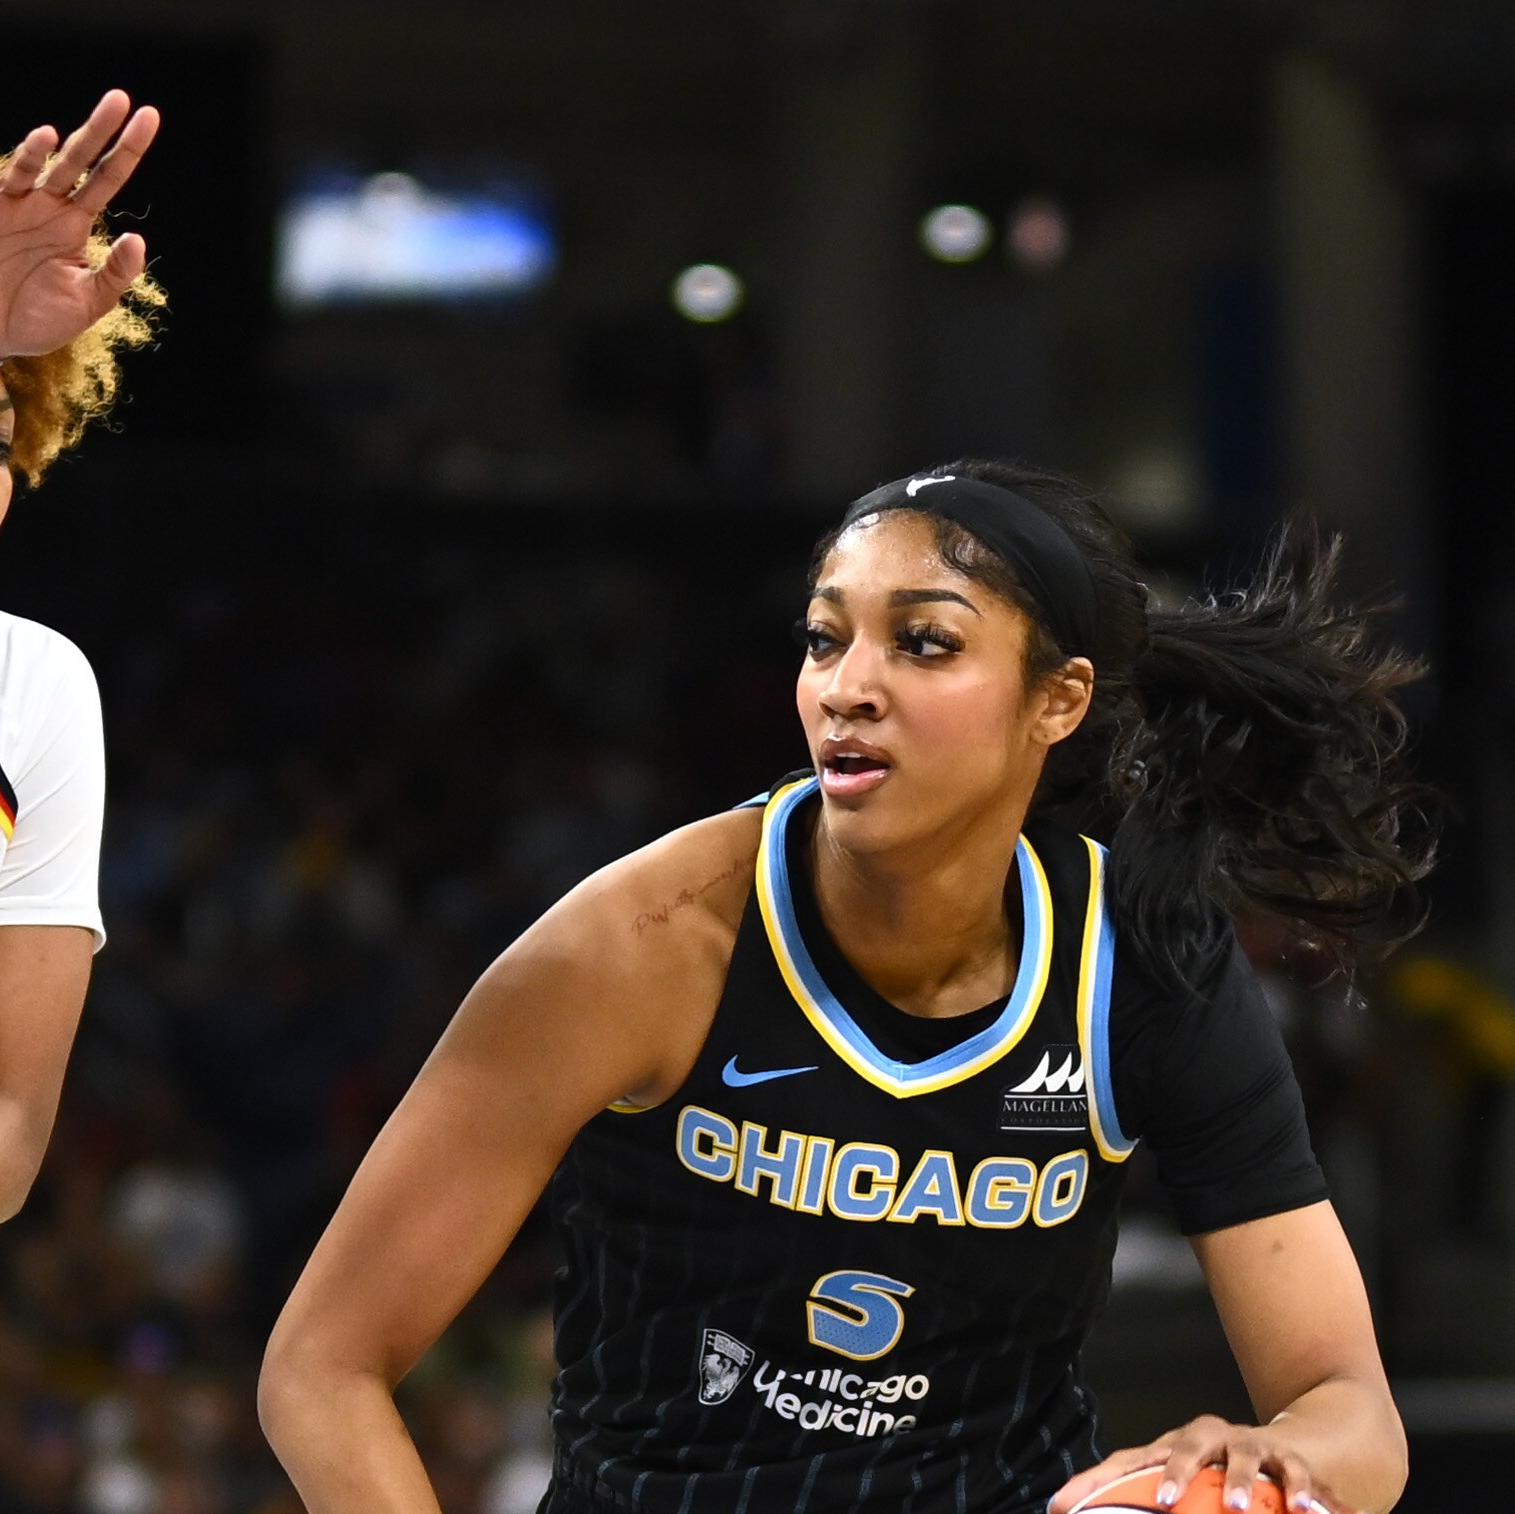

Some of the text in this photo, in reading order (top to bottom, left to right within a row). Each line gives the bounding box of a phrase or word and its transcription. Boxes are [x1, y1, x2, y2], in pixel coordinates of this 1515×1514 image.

[1002, 1100, 1087, 1112] MAGELLAN
[676, 1104, 1089, 1229] CHICAGO
[806, 1269, 916, 1361] 5
